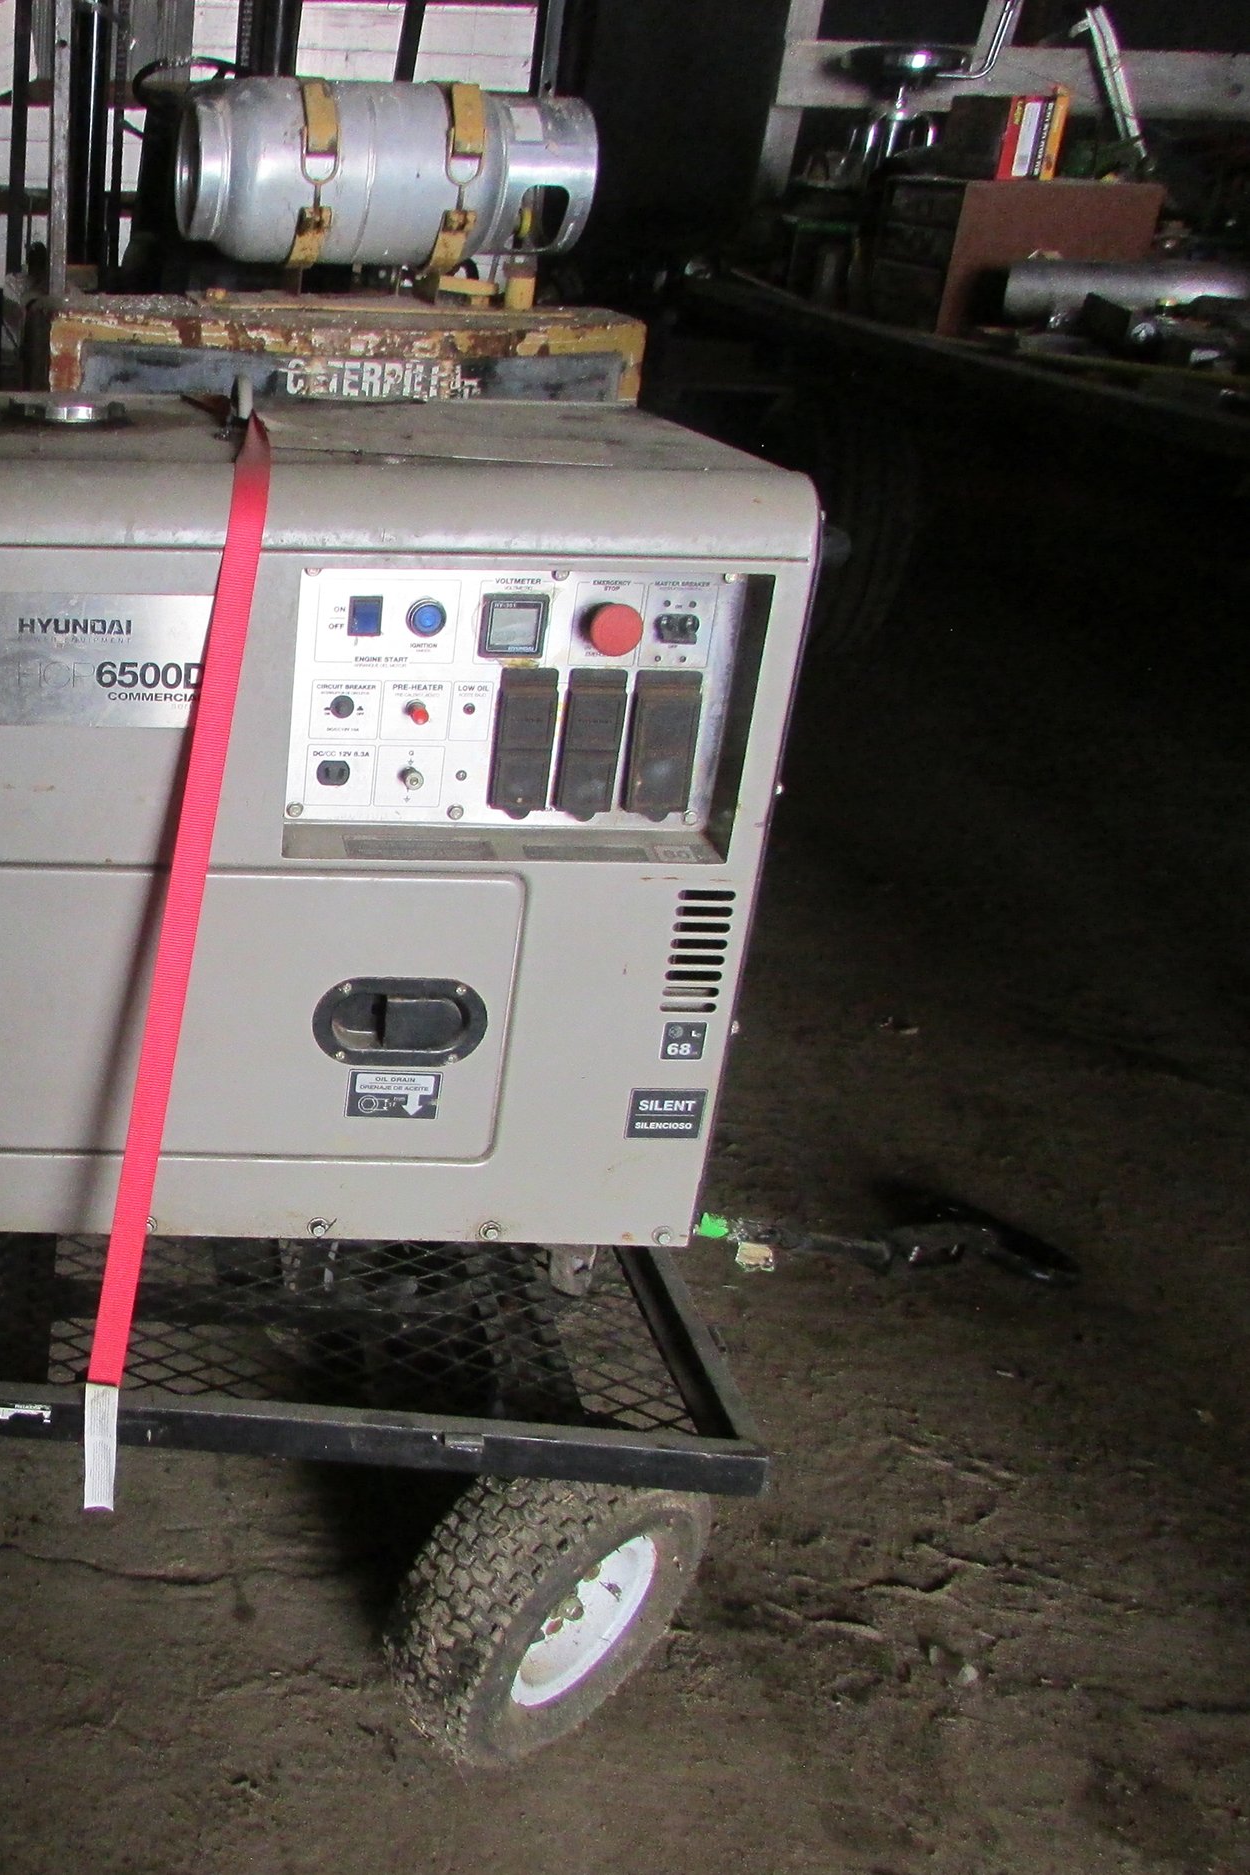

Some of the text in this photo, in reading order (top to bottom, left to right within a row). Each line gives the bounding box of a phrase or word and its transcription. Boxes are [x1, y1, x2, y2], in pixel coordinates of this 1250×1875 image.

[495, 577, 542, 585] VOLTMETER
[17, 617, 132, 635] HYUNDAI
[384, 656, 409, 664] START
[392, 683, 444, 692] PRE-HEATER
[107, 691, 199, 703] COMMERCIA
[666, 1042, 692, 1056] 68
[638, 1100, 696, 1112] SILENT
[634, 1122, 693, 1130] SILENCIOSO
